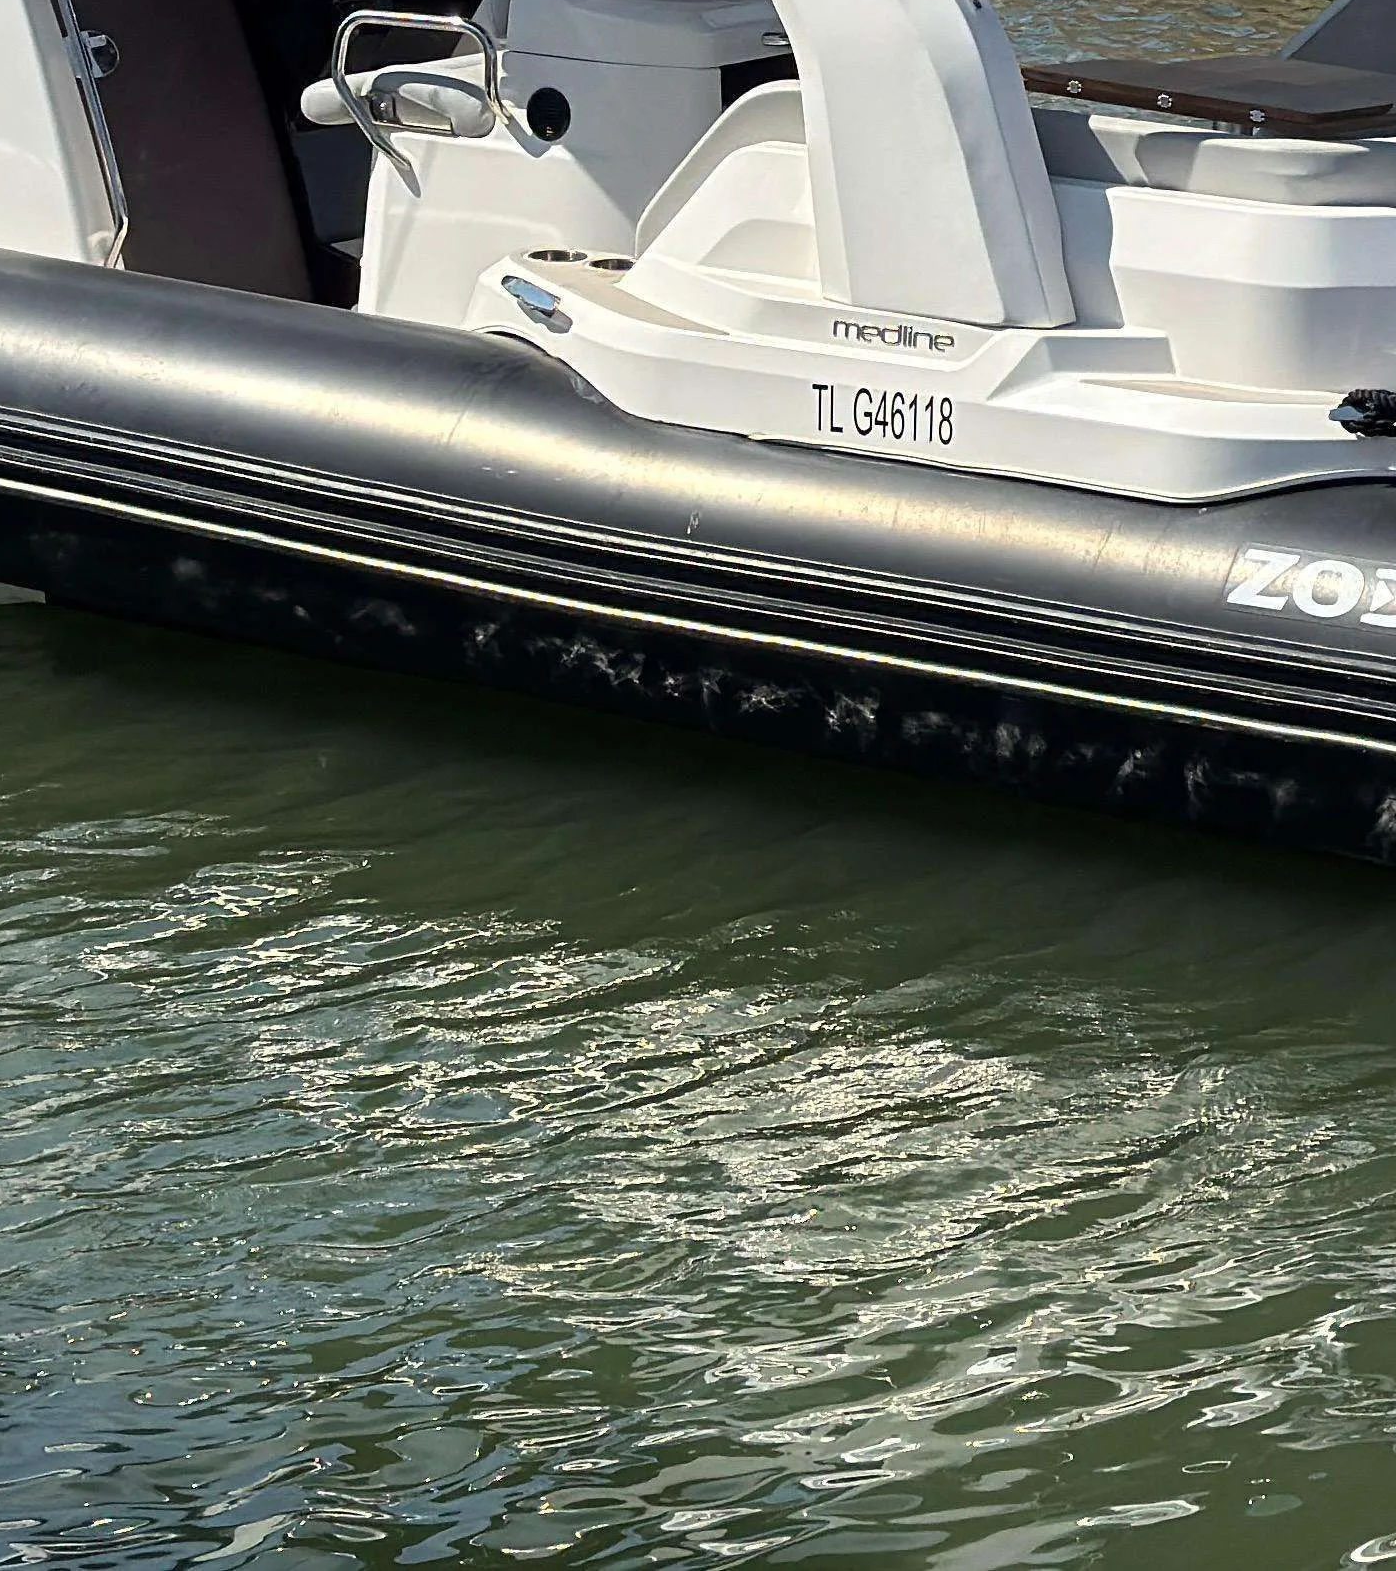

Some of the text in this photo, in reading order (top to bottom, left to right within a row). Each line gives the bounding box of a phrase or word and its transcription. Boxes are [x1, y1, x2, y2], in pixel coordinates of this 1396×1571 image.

[832, 318, 956, 353] medline
[811, 382, 954, 446] TL G46118
